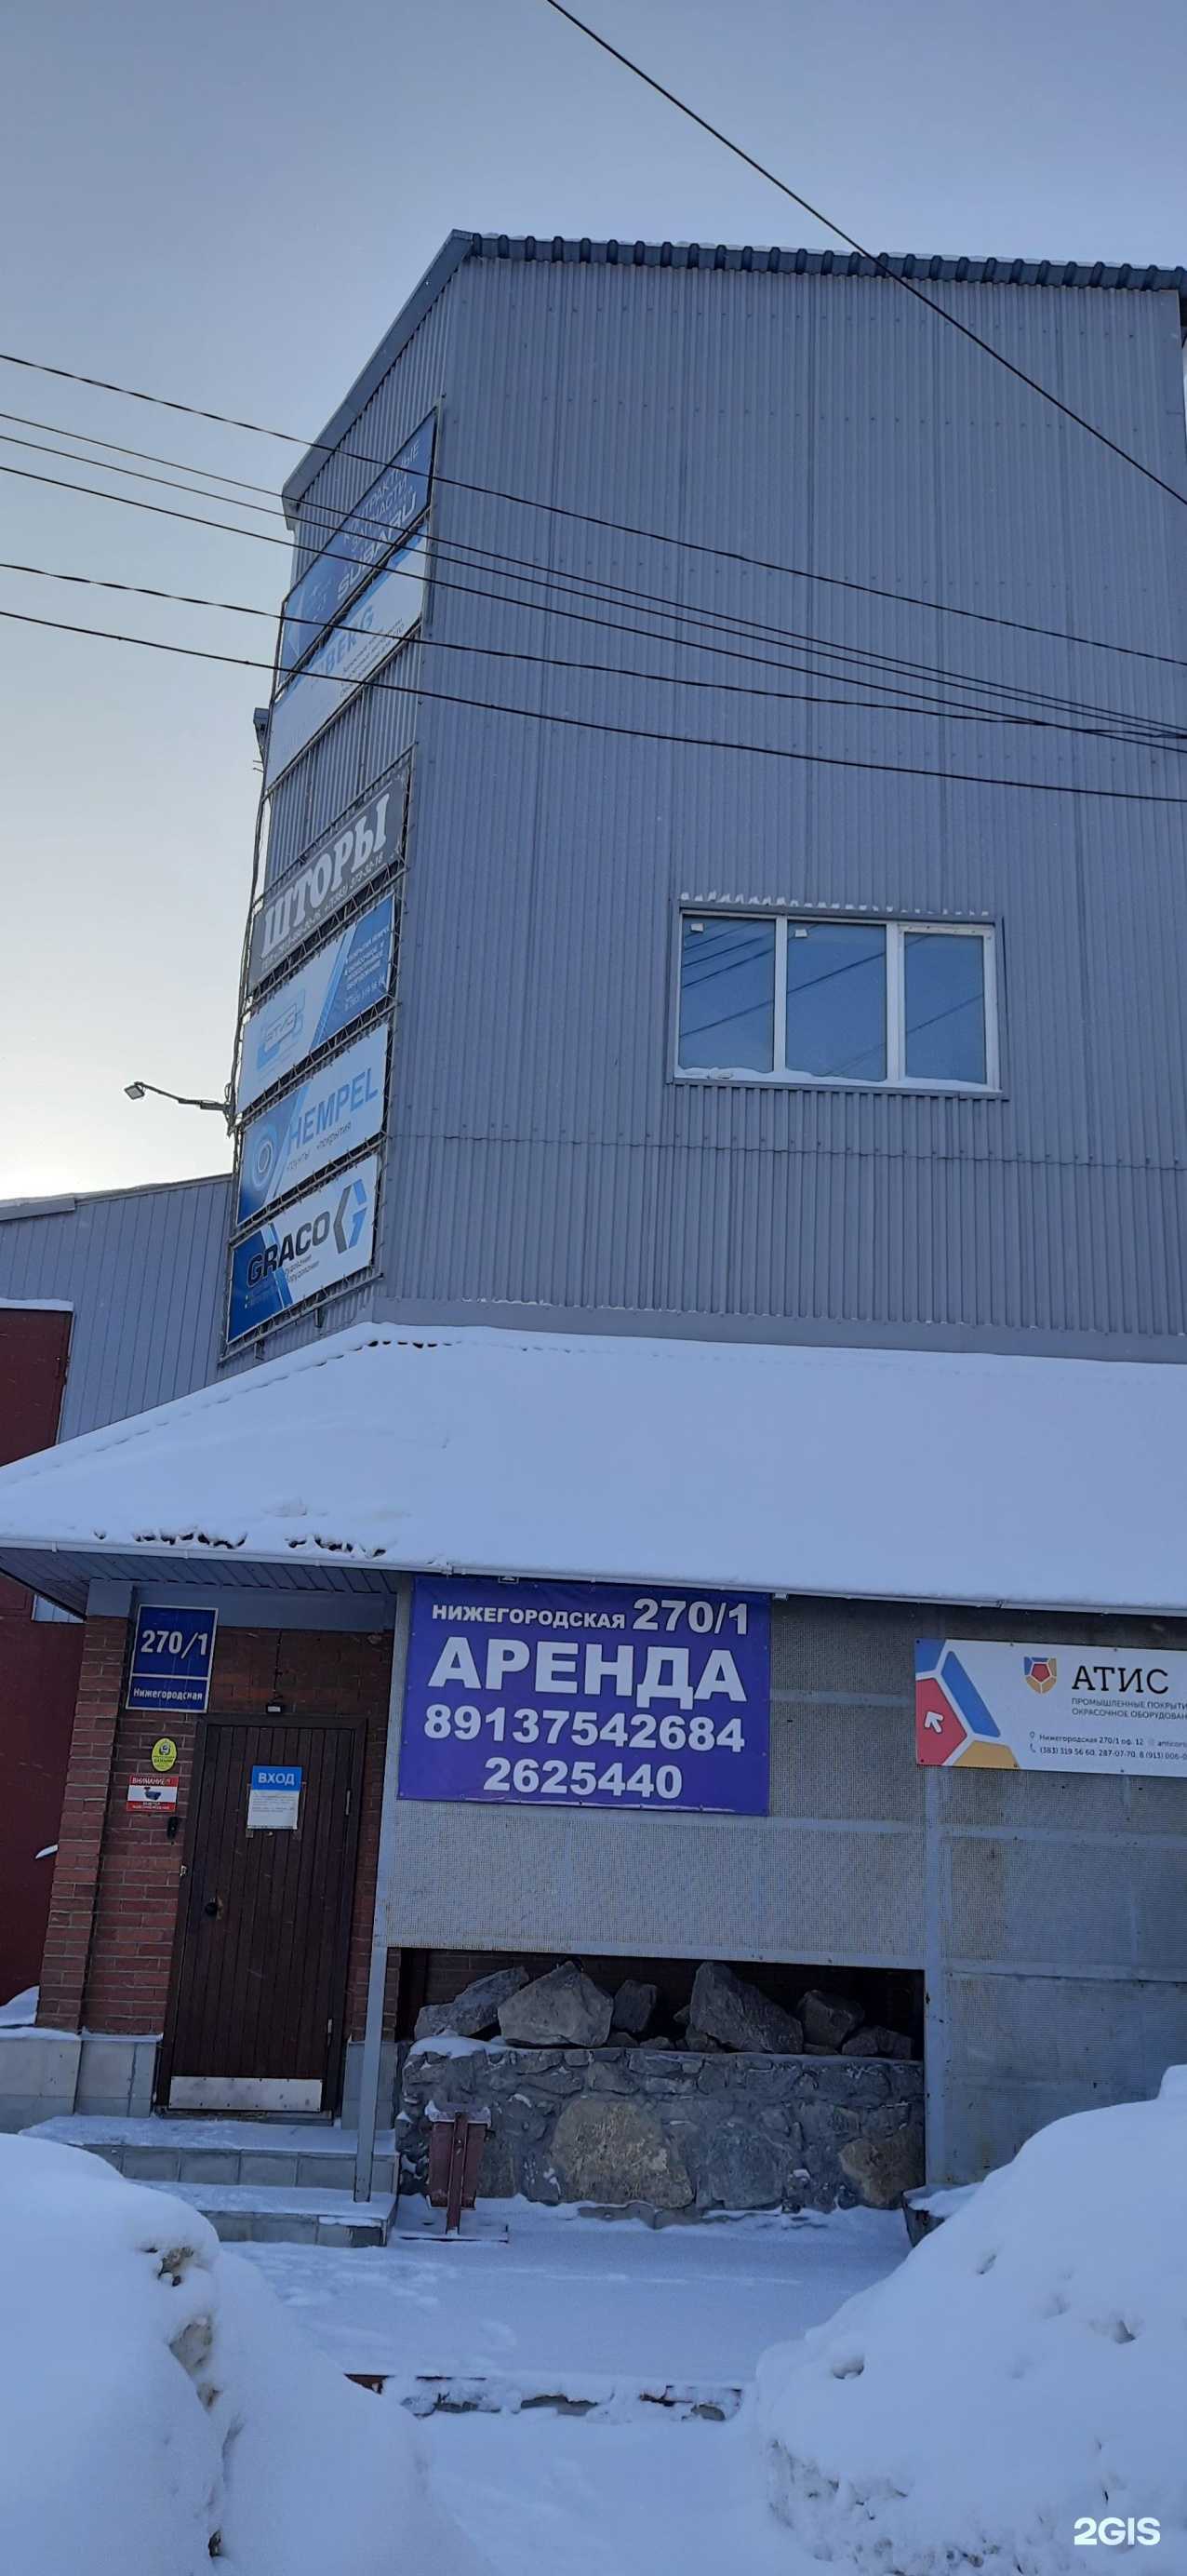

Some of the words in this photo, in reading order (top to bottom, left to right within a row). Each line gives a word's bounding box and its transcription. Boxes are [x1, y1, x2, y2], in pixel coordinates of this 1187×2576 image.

[337, 490, 417, 601] SUBARU
[261, 793, 391, 959] ШТОРЫ
[287, 1067, 380, 1153] HEMPEL
[247, 1210, 331, 1287] GRACO
[432, 1603, 626, 1630] НИЖЕГОРОДСКАЯ
[633, 1597, 748, 1635] 270/1
[140, 1630, 208, 1659] 270/1
[427, 1635, 748, 1711] АРЕНДА
[1072, 1665, 1168, 1695] АТИС
[133, 1687, 203, 1701] Нижегородская
[1072, 1697, 1145, 1709] ПРОМЫШЛЕННЫЕ
[1072, 1707, 1128, 1718] ОКРАСОЧНОЕ
[423, 1703, 745, 1753] 89137542684
[1099, 1737, 1119, 1745] 270/1
[258, 1772, 295, 1787] ВХОД
[483, 1756, 683, 1800] 2625440
